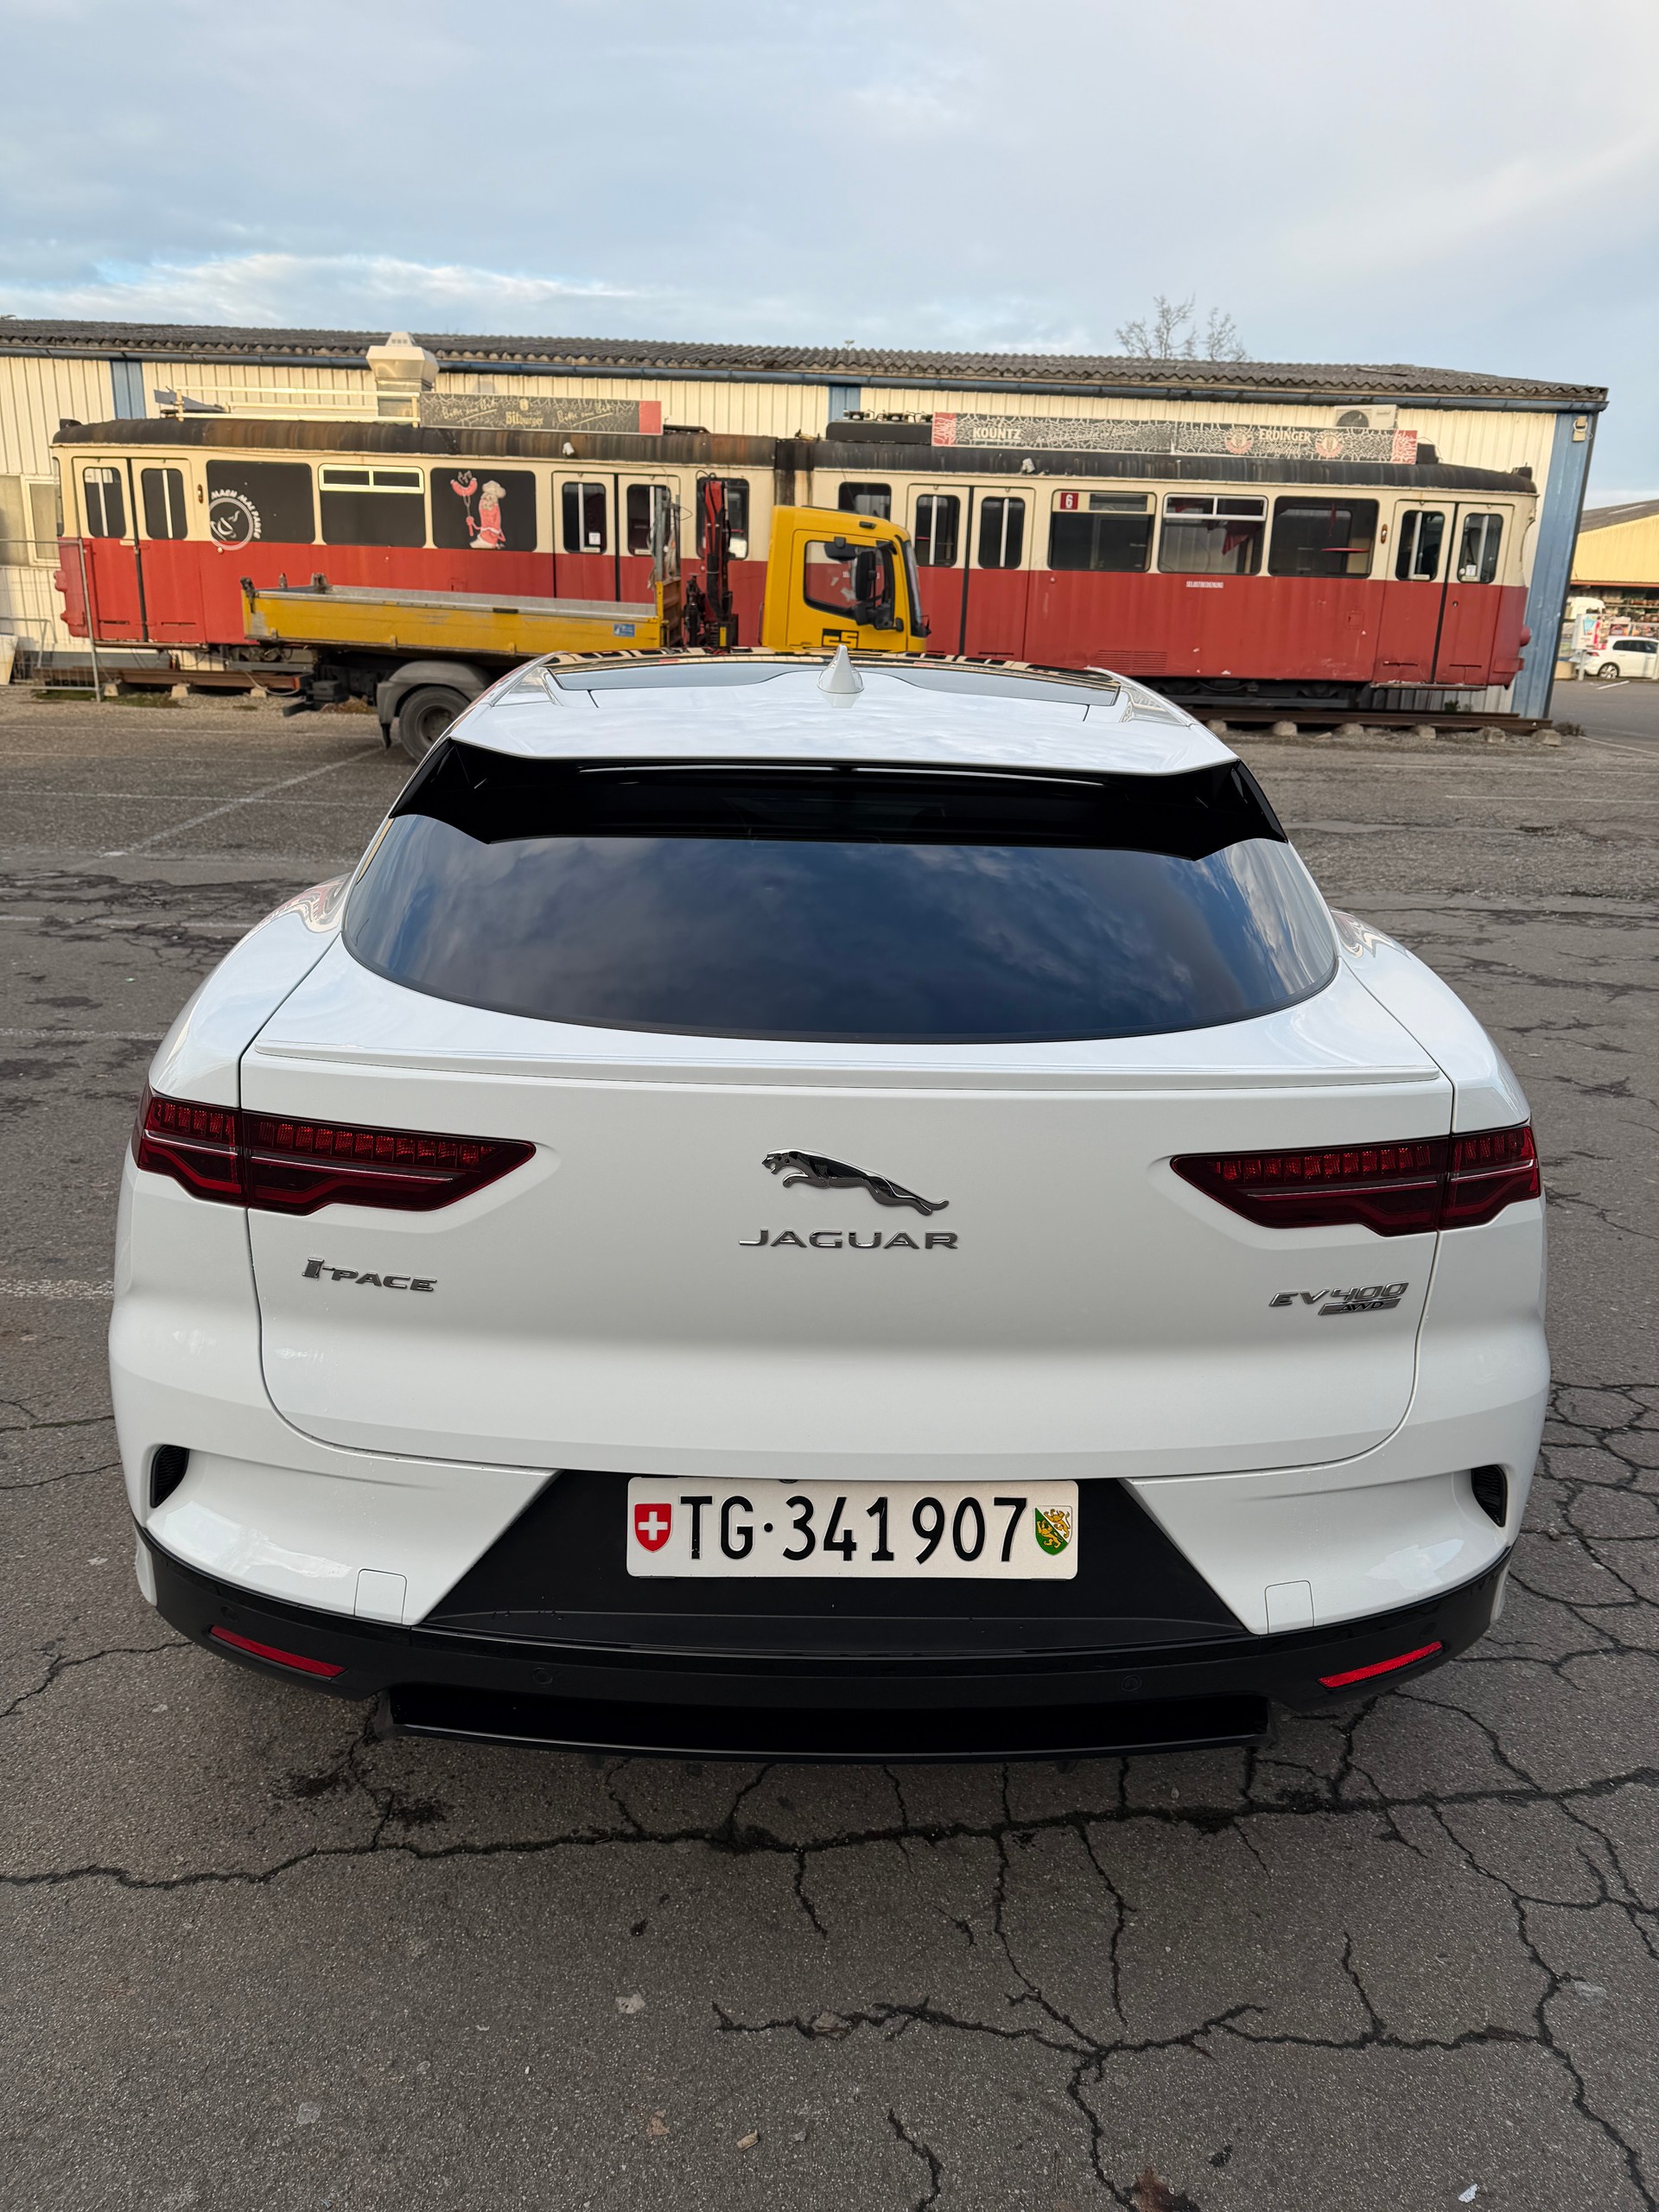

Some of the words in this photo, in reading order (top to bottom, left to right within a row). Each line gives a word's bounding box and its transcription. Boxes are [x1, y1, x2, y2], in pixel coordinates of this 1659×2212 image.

[972, 427, 1021, 440] KOUNTZ
[1258, 428, 1313, 444] ERDINGER
[1065, 493, 1074, 509] 6
[739, 1229, 958, 1249] JAGUAR
[302, 1257, 437, 1293] I-PACE
[1268, 1281, 1409, 1307] EV400
[1340, 1301, 1384, 1313] AWD
